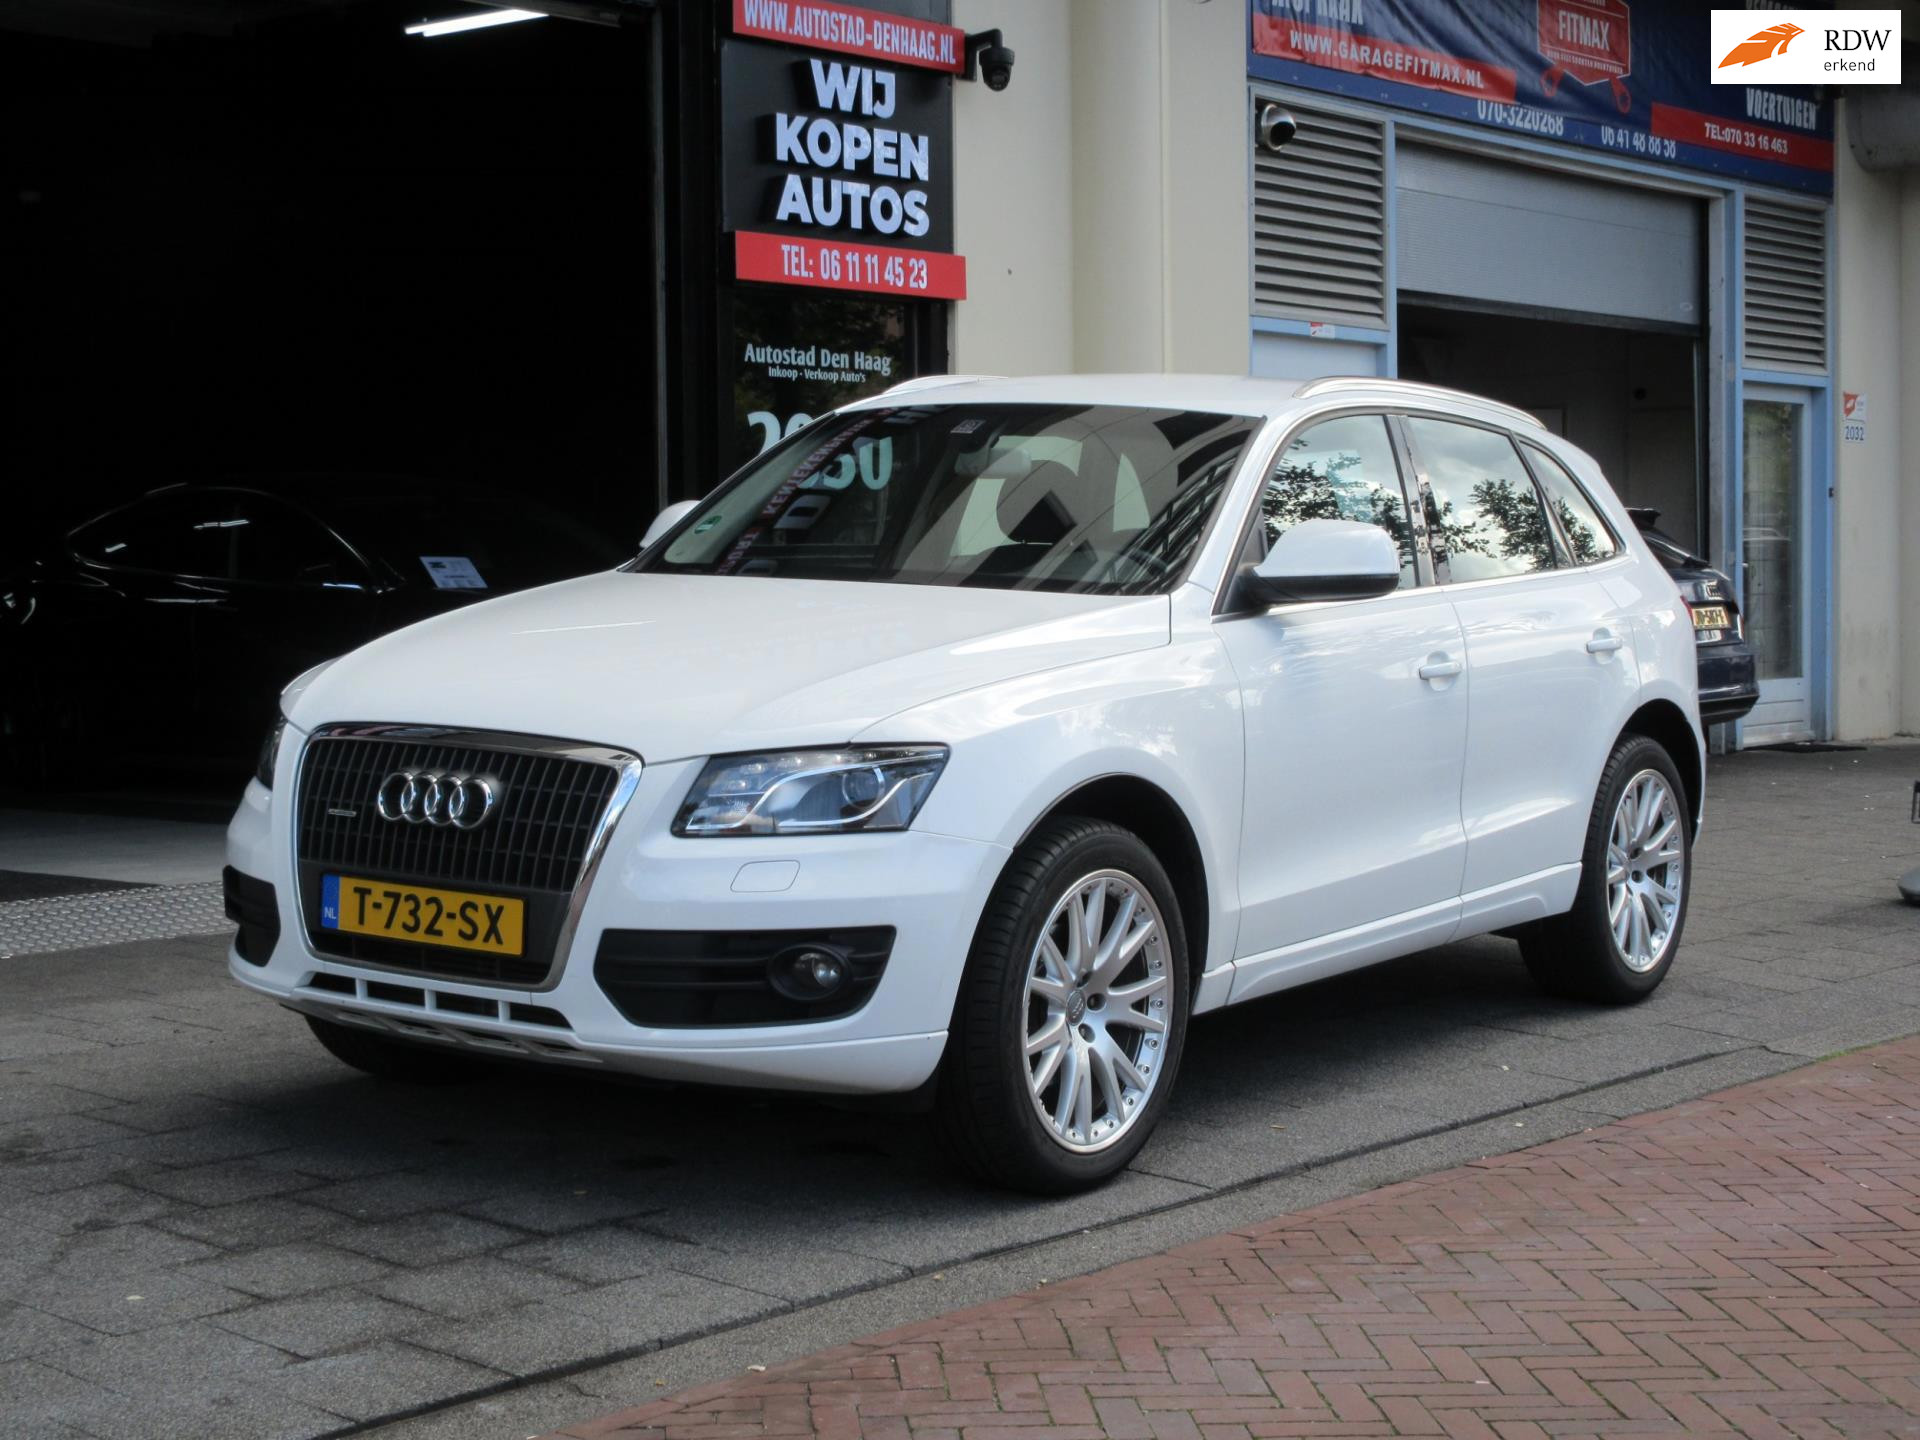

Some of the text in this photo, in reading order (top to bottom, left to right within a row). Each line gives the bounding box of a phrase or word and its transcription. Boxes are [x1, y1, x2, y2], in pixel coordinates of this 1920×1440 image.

[743, 0, 956, 64] WWW.AUTOSTAD-DENHAAG.NL
[1558, 9, 1610, 51] FITMAX
[1289, 29, 1485, 89] WWW.GARAGEFITMAX.NL
[810, 57, 896, 119] WIJ
[1745, 87, 1817, 130] VOERTUIGEN
[775, 112, 930, 181] KOPEN
[1744, 131, 1756, 148] 33
[1757, 134, 1769, 151] 16
[775, 173, 930, 237] AUTOS
[781, 244, 928, 289] TEL: 06 11 11 45 23
[744, 343, 892, 376] Autostad Den Haag
[768, 366, 798, 381] Inkoop
[804, 369, 839, 384] Verkoop
[840, 372, 867, 383] Auto's
[1845, 425, 1865, 441] 2032
[324, 906, 337, 920] NL
[353, 886, 505, 945] T-732-SX
